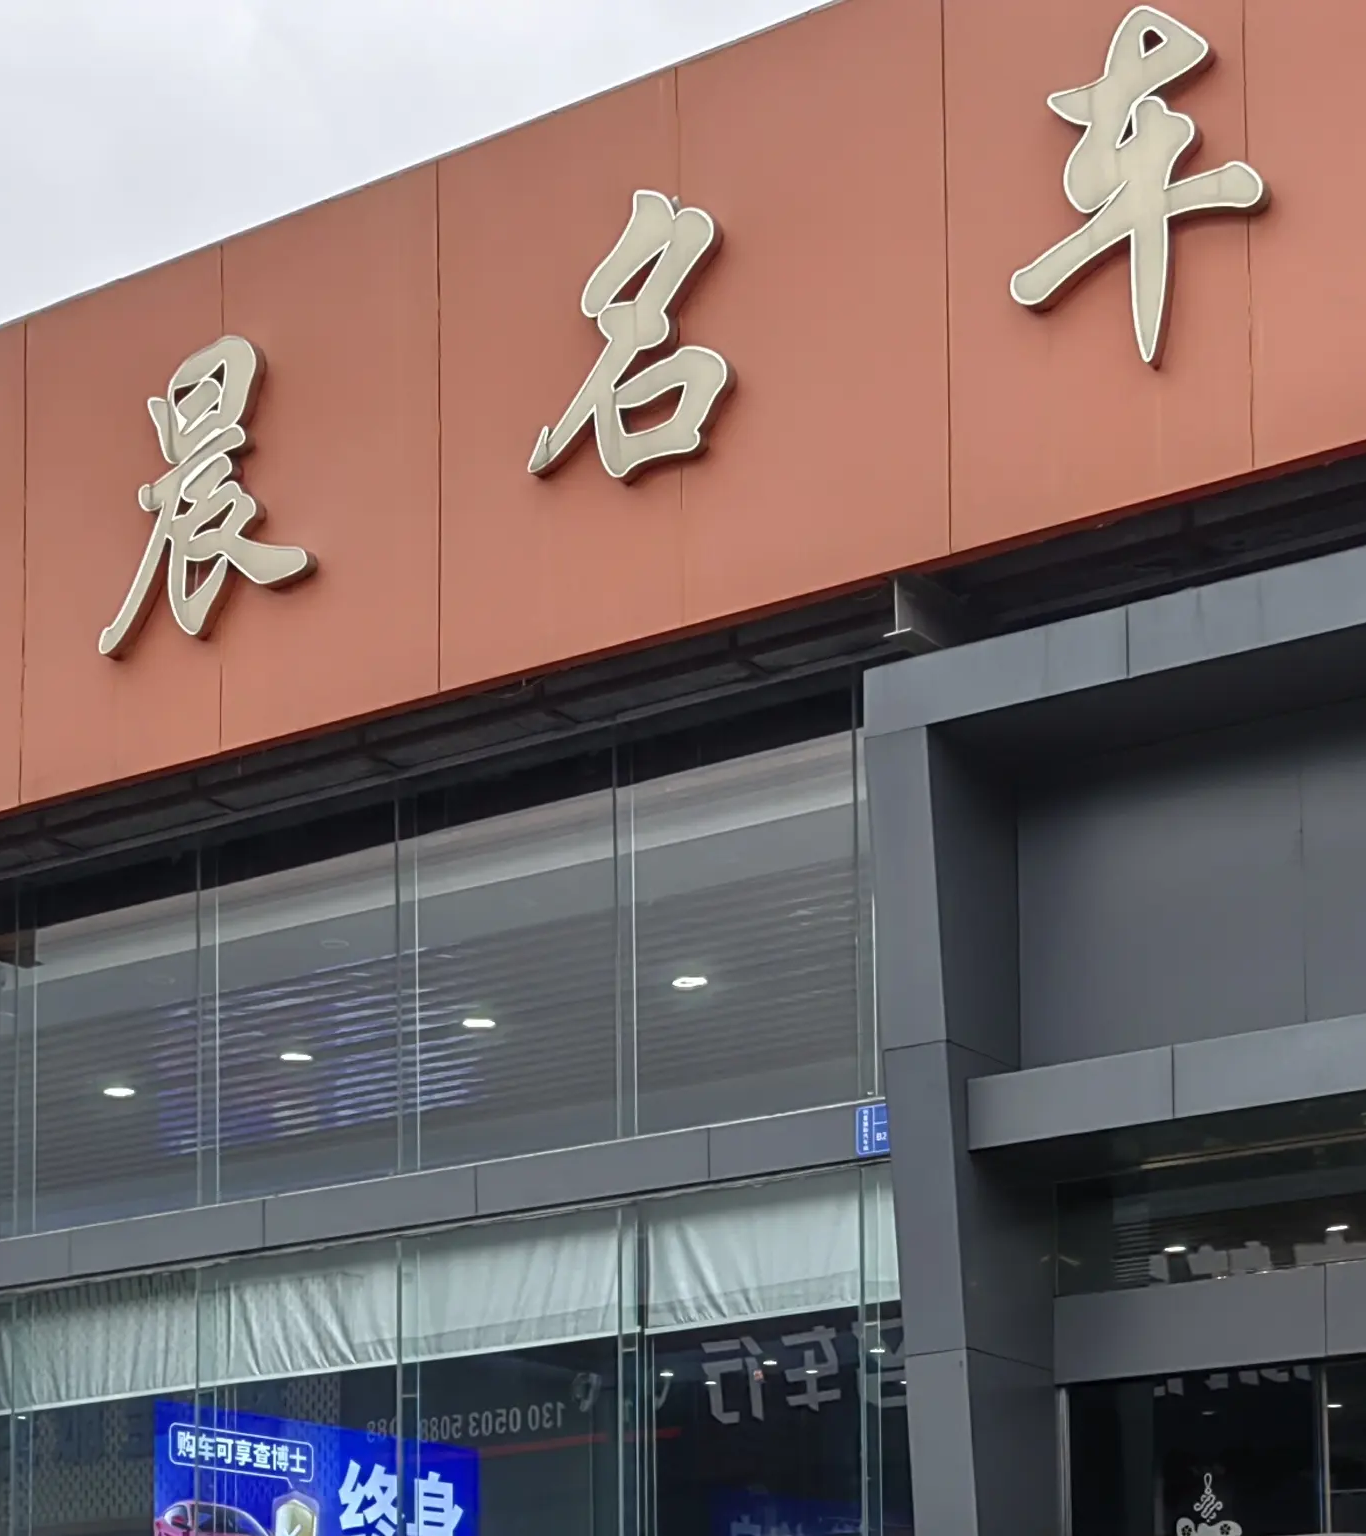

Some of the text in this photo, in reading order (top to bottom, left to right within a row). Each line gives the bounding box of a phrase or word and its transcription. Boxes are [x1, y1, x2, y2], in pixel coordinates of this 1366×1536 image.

[176, 1431, 307, 1474] 购车可享查博士
